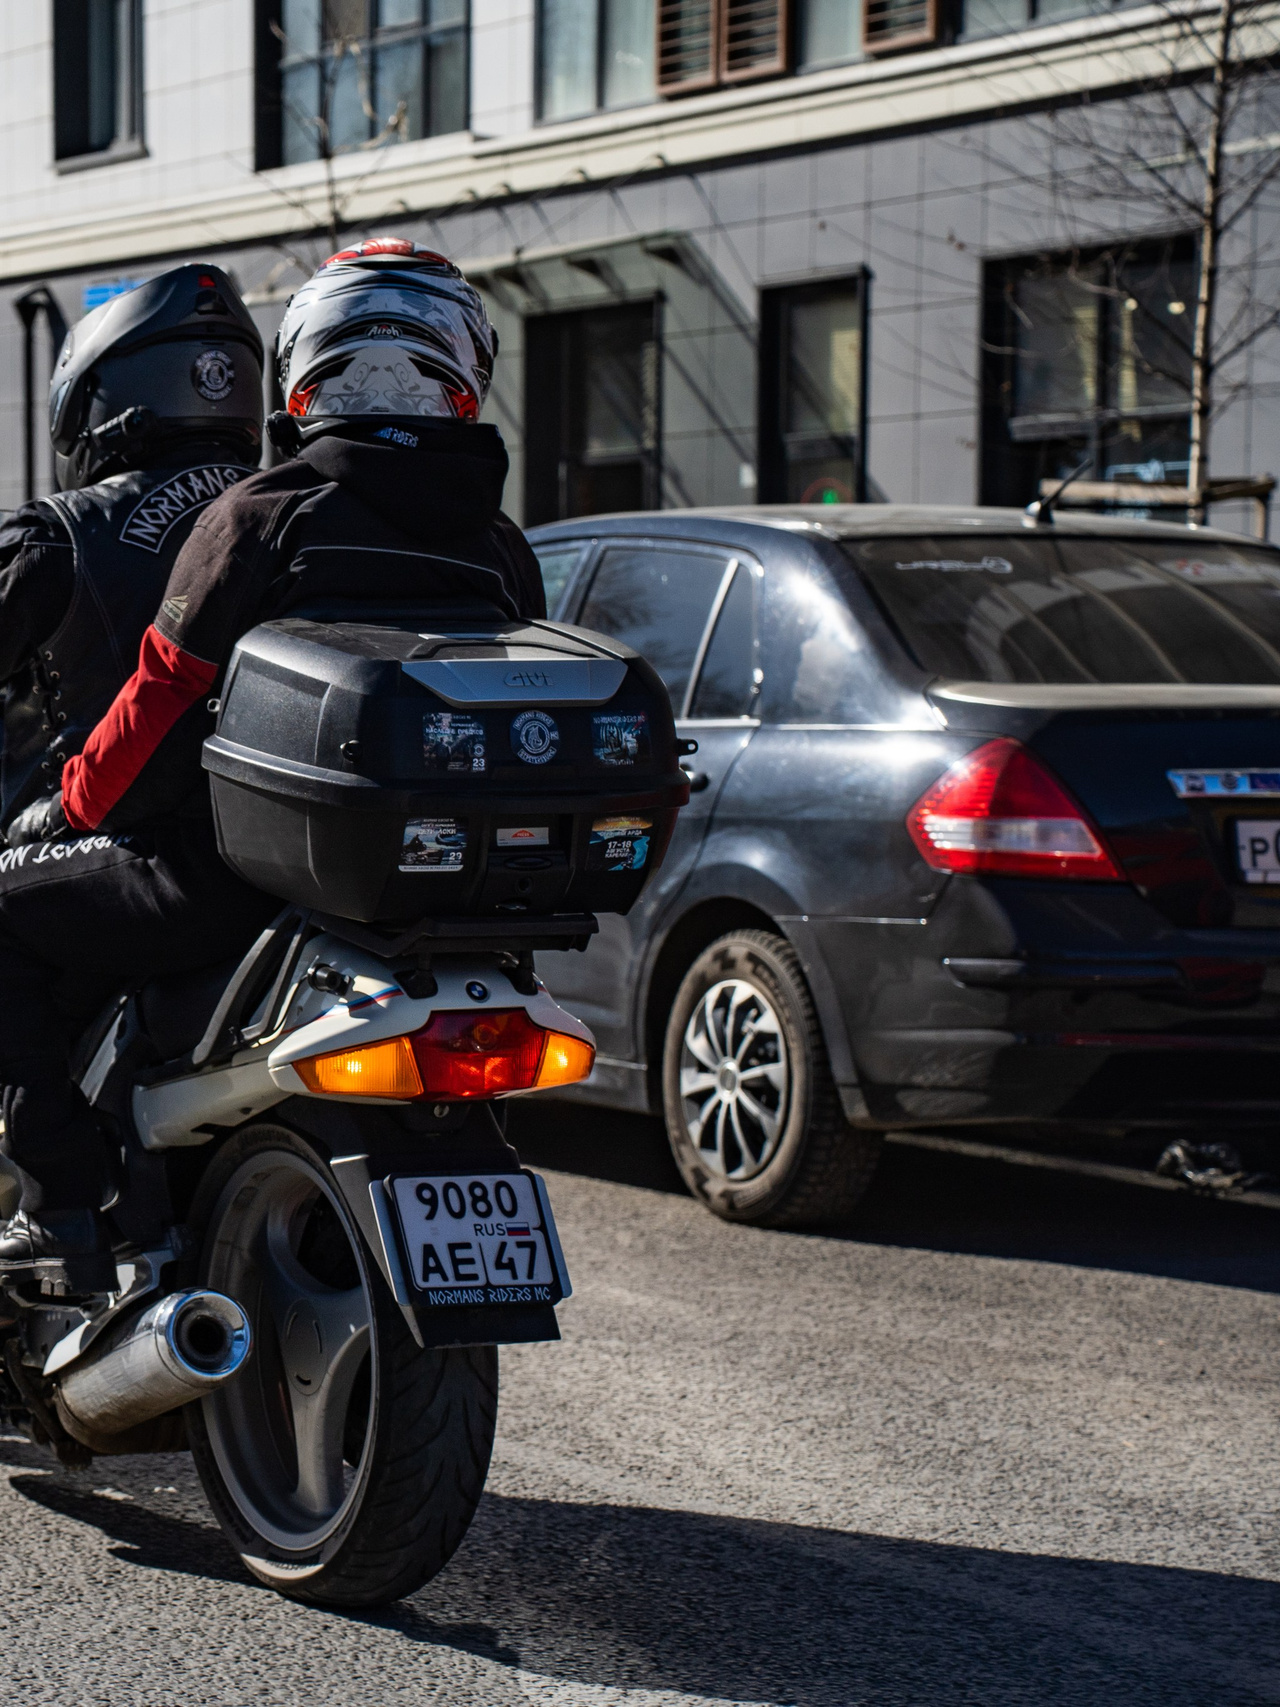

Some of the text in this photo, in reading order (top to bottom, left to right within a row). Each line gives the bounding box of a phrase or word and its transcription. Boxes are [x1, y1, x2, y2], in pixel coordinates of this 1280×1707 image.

[367, 325, 400, 338] Airoh
[126, 467, 241, 543] NORMANS
[472, 757, 486, 767] 23
[607, 840, 632, 849] 17-18
[415, 1180, 518, 1221] 9080
[474, 1222, 506, 1237] RUS
[494, 1240, 538, 1281] 47
[428, 1286, 551, 1305] NORMANS RIDERS MC
